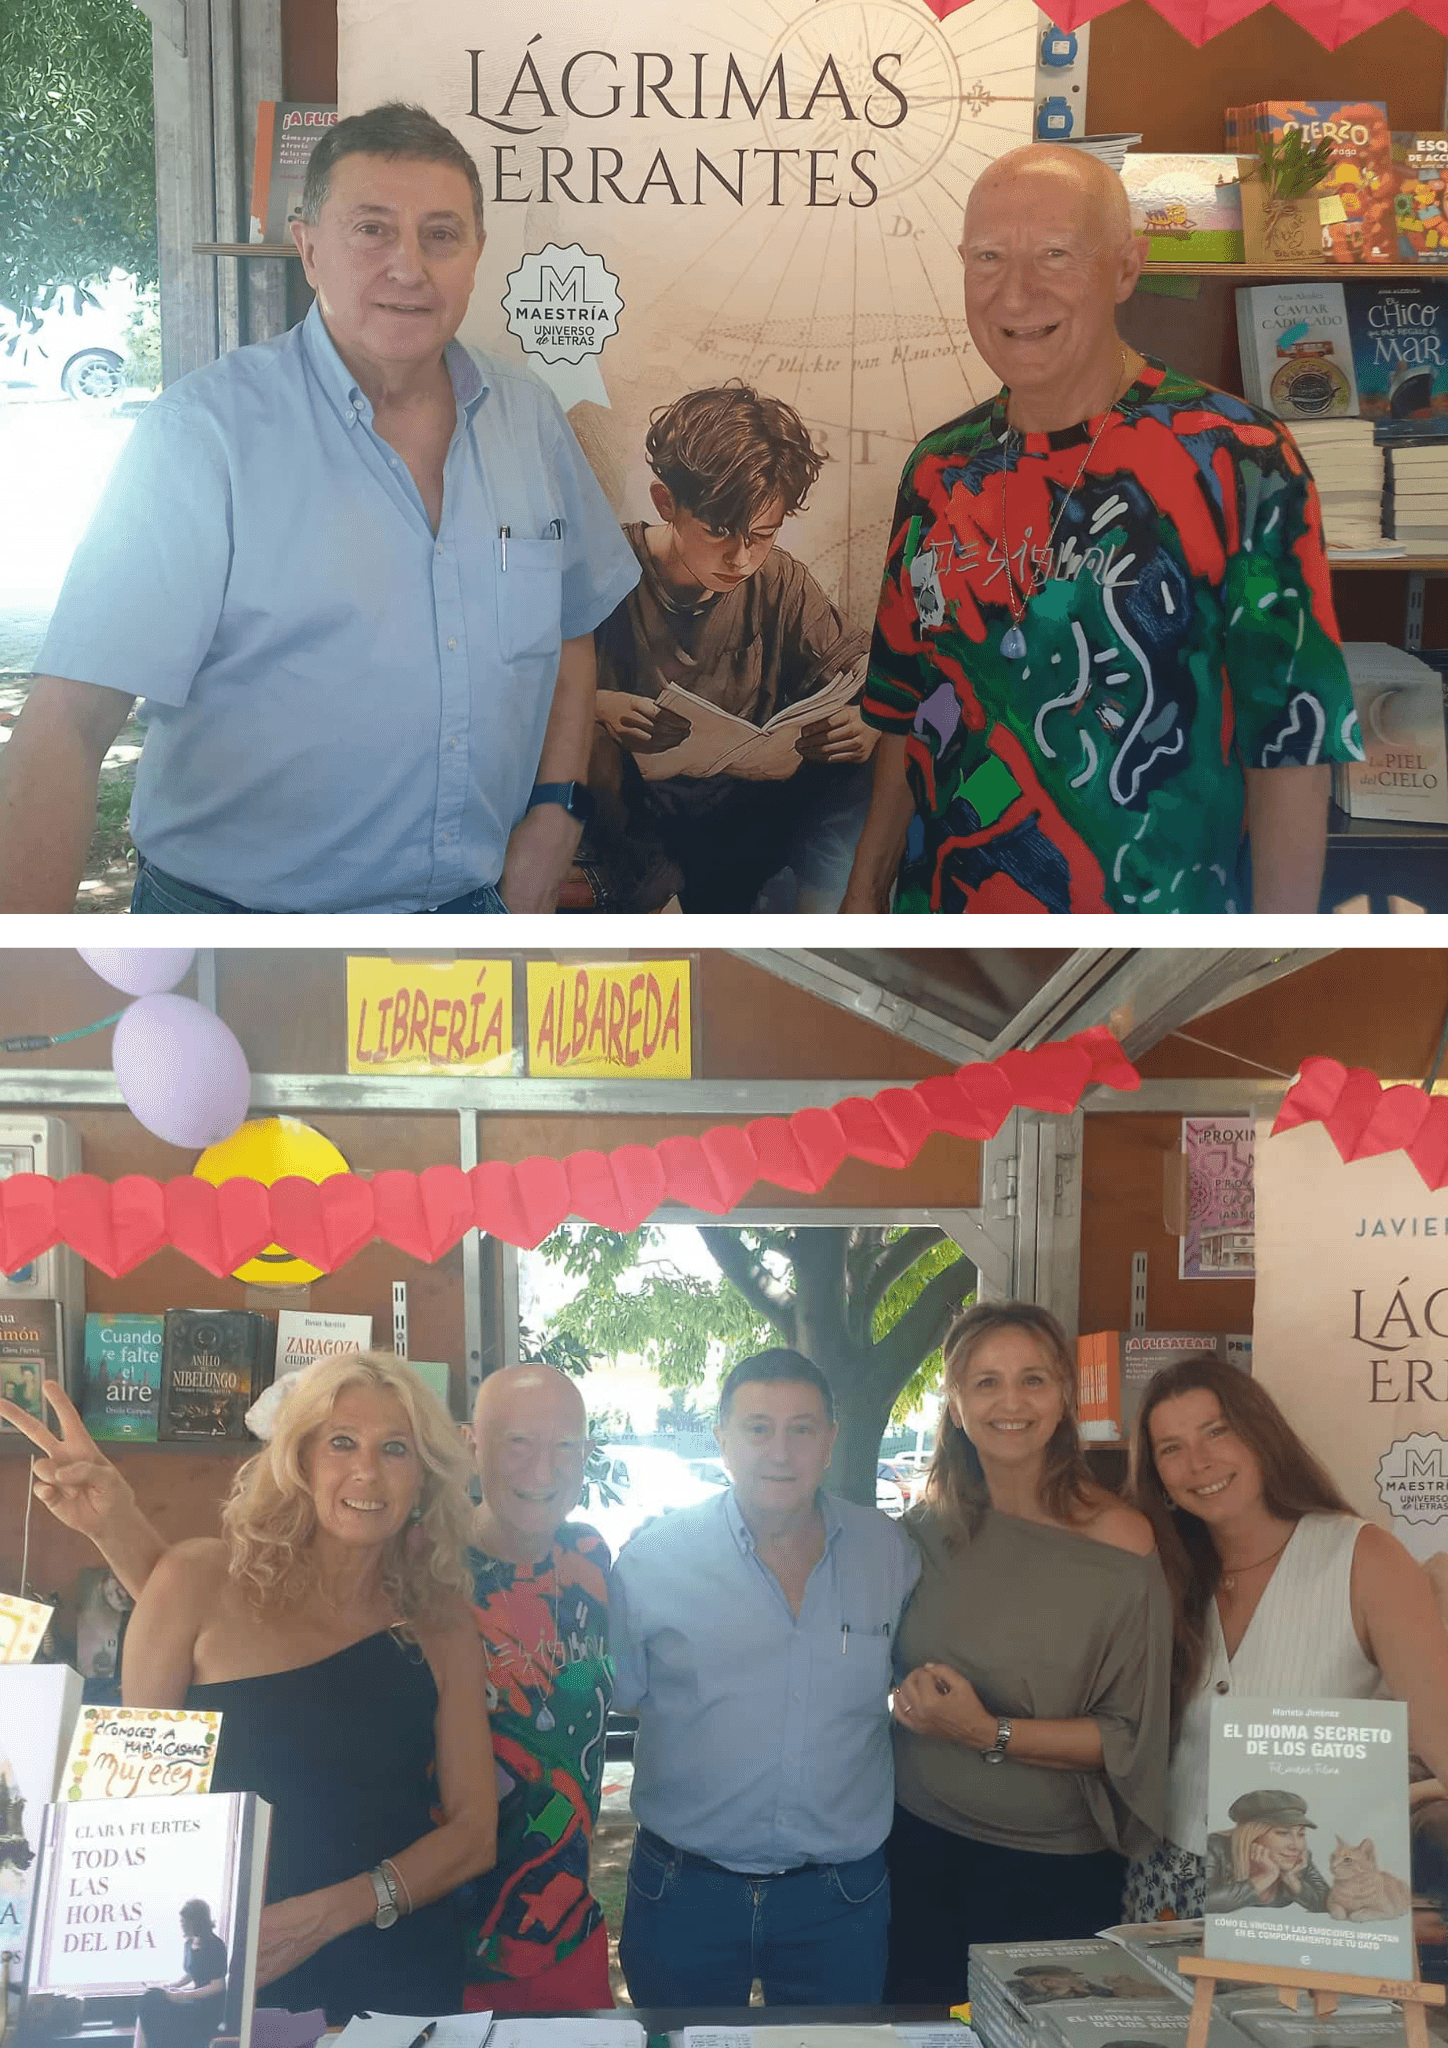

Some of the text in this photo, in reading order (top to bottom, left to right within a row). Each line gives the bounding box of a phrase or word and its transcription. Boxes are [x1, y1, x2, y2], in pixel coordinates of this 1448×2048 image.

[464, 33, 908, 134] LÁGRIMAS
[1408, 154, 1448, 162] DE ACC
[491, 145, 878, 207] ERRANTES
[516, 306, 609, 321] MAESTRÍA
[1274, 304, 1329, 316] CAVIAR
[534, 325, 595, 336] UNIVERSO
[552, 336, 594, 346] LETRAS
[1386, 753, 1427, 770] PIEL
[1378, 771, 1438, 789] CIELO
[356, 966, 503, 1066] LIBRERÍA
[536, 968, 679, 1067] ALBAREDA
[1355, 1217, 1448, 1237] JAVIE
[100, 1328, 162, 1344] Cuando
[121, 1346, 159, 1363] falte
[287, 1337, 361, 1355] ZARAGOZA
[122, 1366, 134, 1379] el
[173, 1371, 237, 1389] NIBELUNGO
[1369, 1359, 1448, 1403] ER
[106, 1380, 152, 1402] aire
[1386, 1481, 1448, 1491] MAESTR
[1223, 1723, 1392, 1744] EL IDIOMA SECRETO
[1246, 1740, 1367, 1759] DE LOS GATOS
[75, 1819, 200, 1838] CLARA FUERTES
[72, 1847, 146, 1869] TODAS
[69, 1877, 109, 1897] LAS
[66, 1902, 142, 1925] HORAS
[62, 1924, 157, 1953] DEL DÍA
